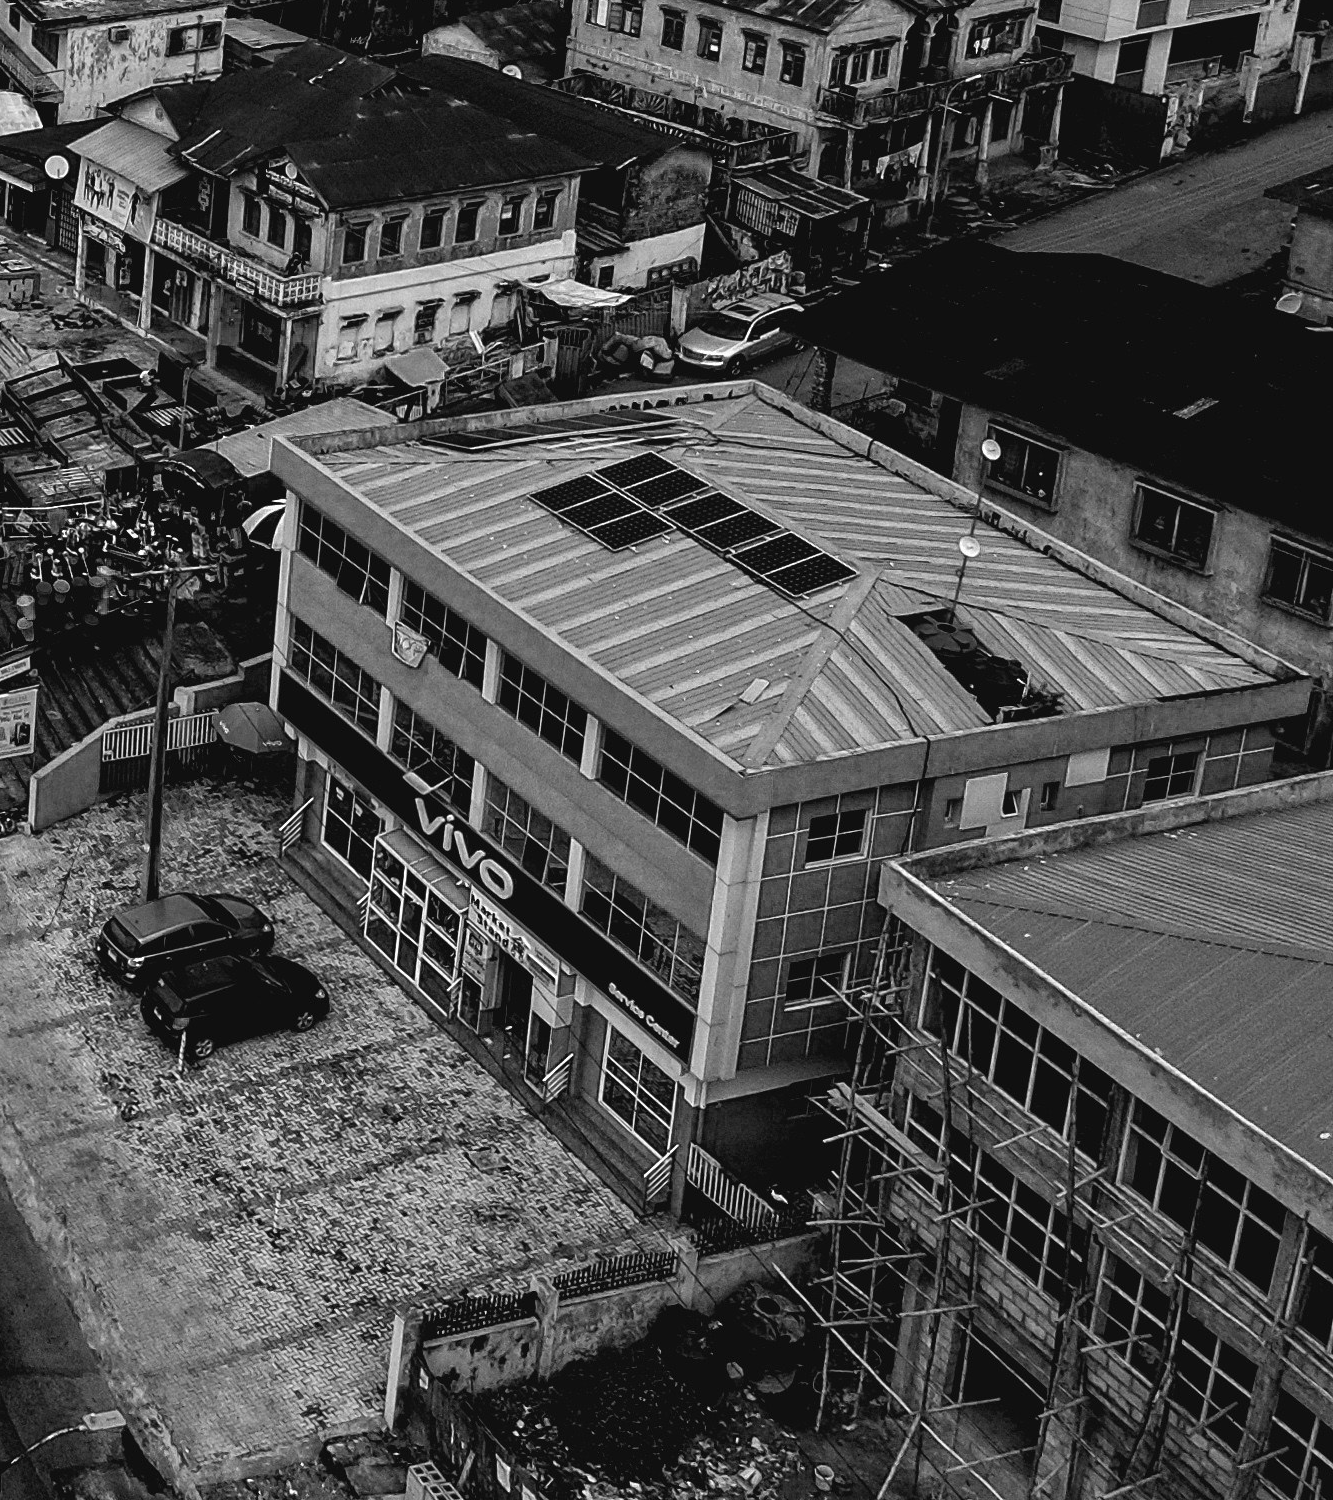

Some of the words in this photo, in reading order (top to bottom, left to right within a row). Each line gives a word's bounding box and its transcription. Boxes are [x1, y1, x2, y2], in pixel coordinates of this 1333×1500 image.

[415, 797, 514, 900] vivo
[471, 894, 510, 936] Market
[608, 982, 644, 1019] Service
[645, 1014, 681, 1049] Center
